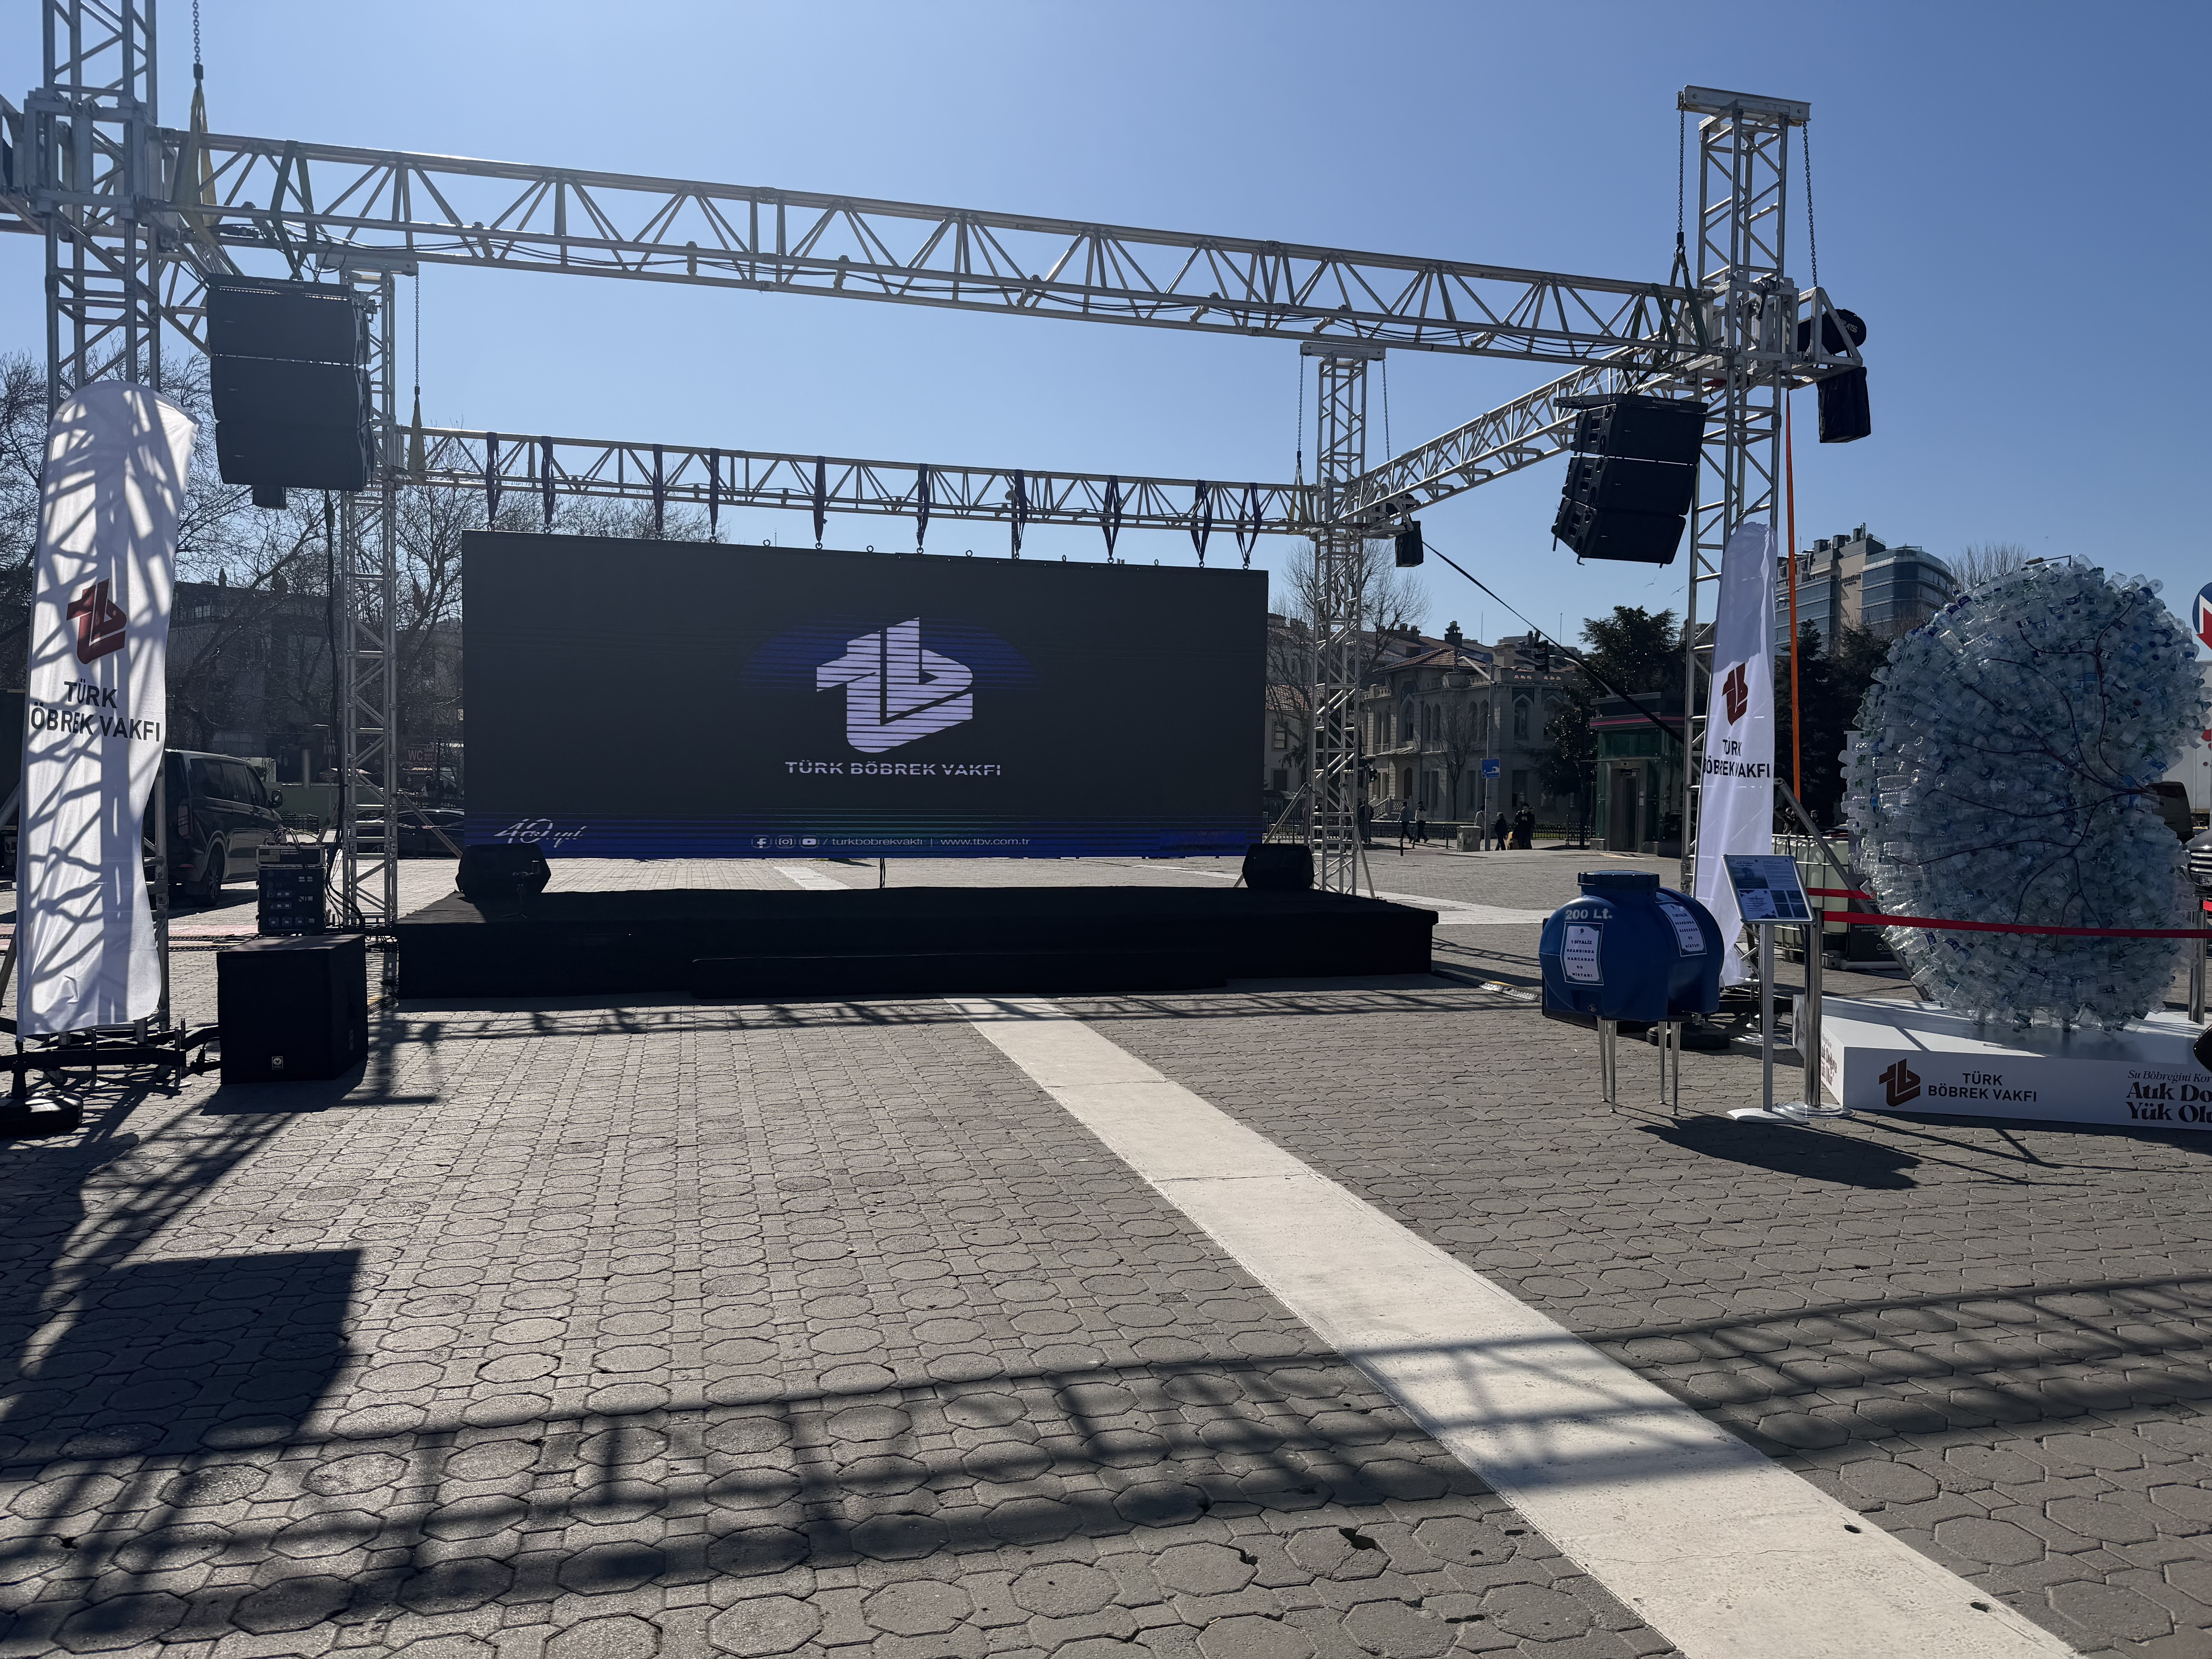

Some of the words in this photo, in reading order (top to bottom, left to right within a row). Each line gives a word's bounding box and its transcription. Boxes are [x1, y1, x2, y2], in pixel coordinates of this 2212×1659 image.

[64, 678, 118, 709] TÜRK
[31, 702, 94, 735] ÖBREK
[100, 715, 160, 742] VAKFI
[408, 749, 423, 761] WC
[1723, 737, 1742, 756] TÜRK
[785, 760, 843, 774] TÜRK
[851, 761, 936, 775] BÖBREK
[942, 764, 1001, 775] VAKFI
[1735, 762, 1770, 778] VAKFI
[1565, 909, 1588, 920] 200
[1593, 908, 1613, 919] Lt.
[1962, 1071, 2003, 1086] TÜRK
[2128, 1070, 2141, 1079] Su
[2143, 1071, 2191, 1084] Böbreğini
[1929, 1083, 1989, 1099] BÖBREK
[1993, 1089, 2037, 1102] VAKFI
[2126, 1082, 2175, 1100] Atık
[2125, 1101, 2174, 1121] Yük
